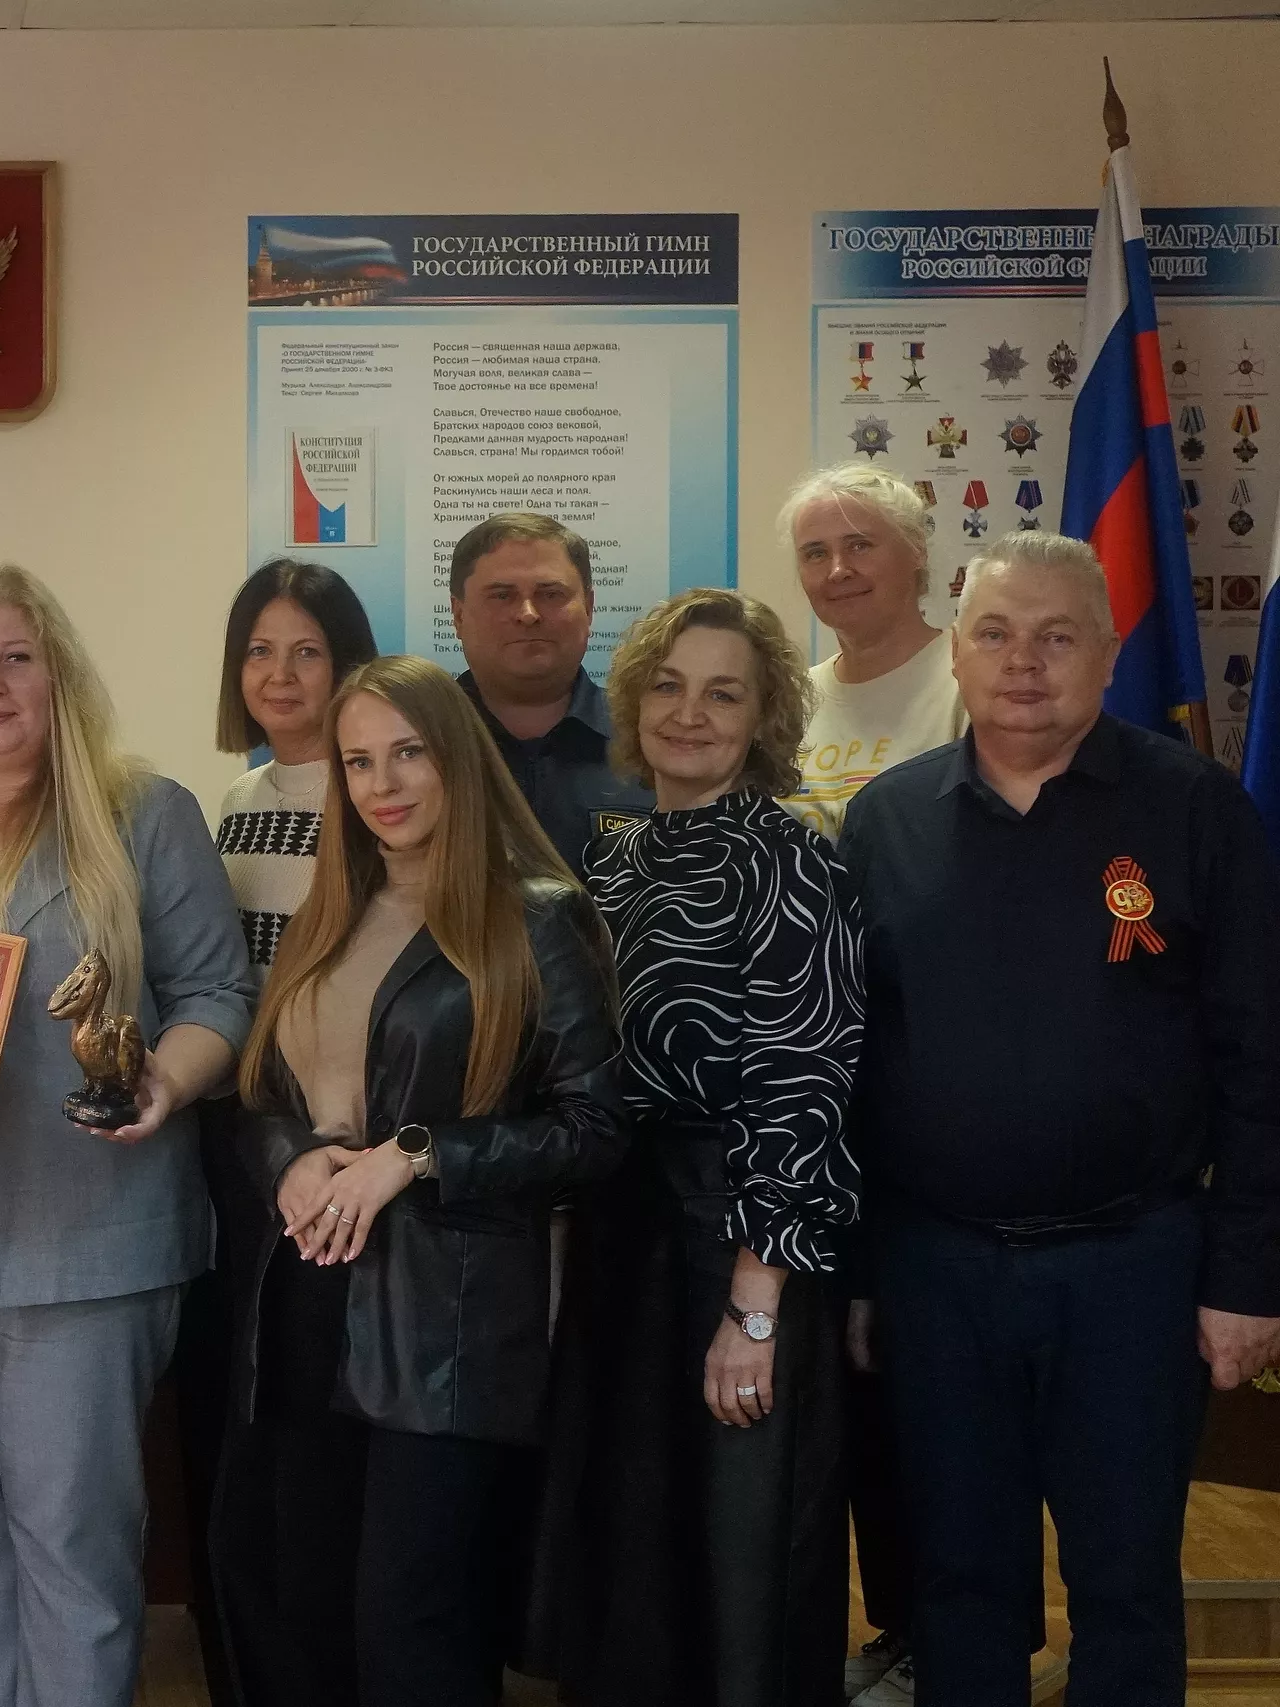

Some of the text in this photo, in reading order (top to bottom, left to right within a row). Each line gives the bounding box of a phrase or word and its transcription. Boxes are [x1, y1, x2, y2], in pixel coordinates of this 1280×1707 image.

[412, 233, 710, 256] ГОСУДАРСТВЕННЫЙ ГИМН
[412, 255, 711, 279] РОССИЙСКОЙ ФЕДЕРАЦИИ
[901, 254, 1064, 278] РОССИЙСКОЙ
[433, 343, 620, 352] Россия священная наша держава,
[433, 356, 469, 364] Россия
[483, 355, 530, 364] любимая
[533, 356, 560, 364] наша
[433, 369, 476, 379] Могучая
[479, 370, 504, 378] воля,
[552, 369, 581, 377] слава
[433, 382, 456, 391] Твое
[459, 383, 511, 391] достоянье
[550, 381, 598, 391] времена!
[433, 407, 621, 417] Славься, Отечество наше свободное,
[433, 420, 601, 431] Братских народов союз вековой,
[300, 437, 363, 447] КОНСТИТУЦИЯ
[433, 433, 628, 444] Предками данная мудрость народная!
[303, 448, 360, 459] РОССИЙСКОЙ
[433, 447, 624, 457] Славься, страна! Мы гордимся тобой!
[306, 463, 357, 473] ФЕДЕРАЦИИ
[433, 473, 616, 483] От южных морей до полярного края
[433, 487, 497, 496] Раскинулись
[531, 487, 554, 495] леса
[557, 487, 563, 495] и
[566, 487, 591, 495] поля.
[433, 500, 458, 509] Одна
[462, 500, 474, 508] ты
[493, 500, 523, 508] свете!
[527, 500, 552, 509] Одна
[555, 500, 567, 508] ты
[570, 500, 598, 508] такая
[433, 513, 485, 523] Хранимая
[562, 513, 595, 521] земля!
[434, 644, 450, 652] Так
